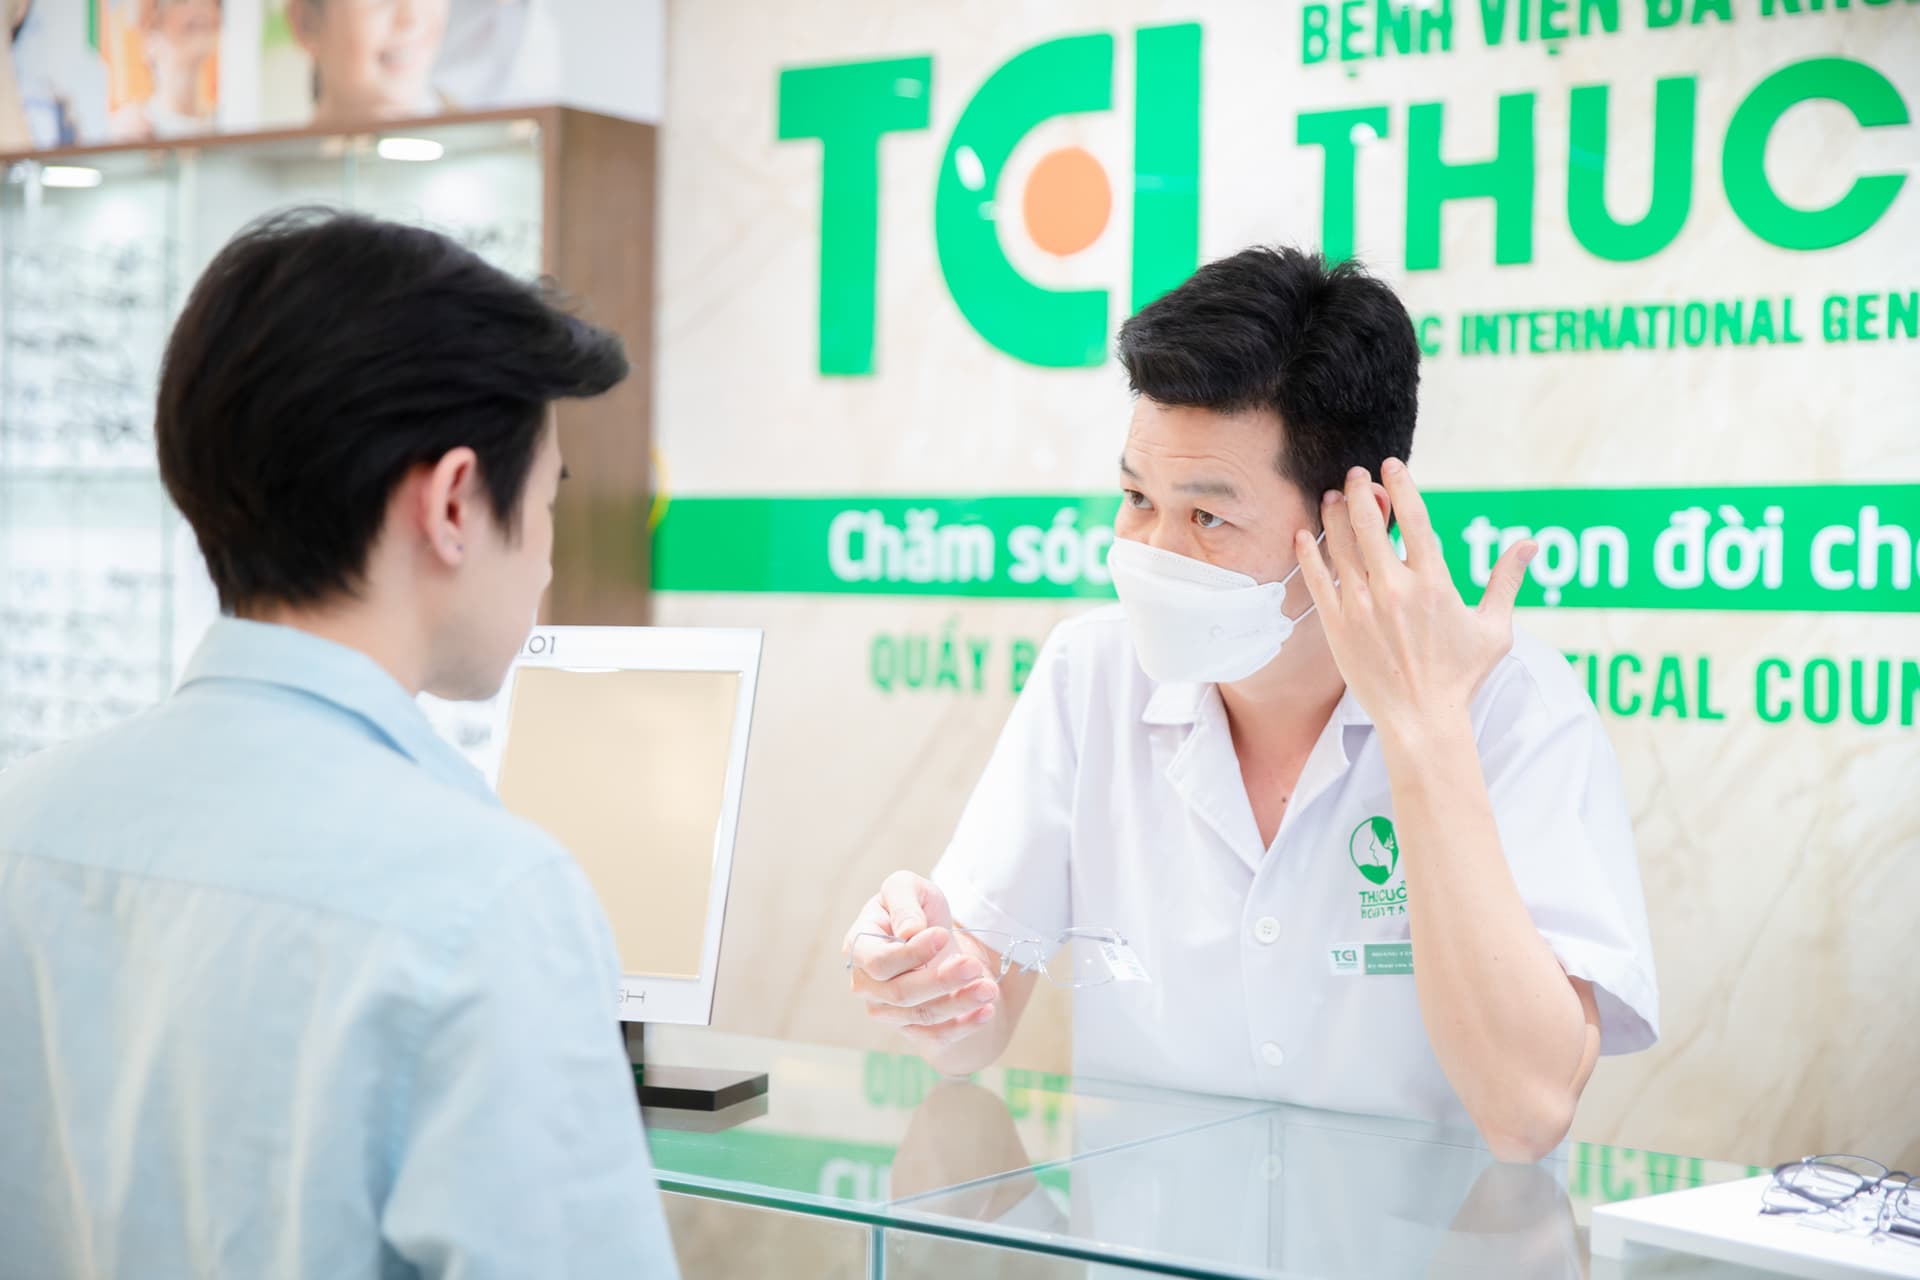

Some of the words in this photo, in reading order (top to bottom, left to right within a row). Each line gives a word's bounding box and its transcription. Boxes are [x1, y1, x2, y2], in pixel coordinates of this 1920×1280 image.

[777, 22, 1202, 376] TCI
[1461, 297, 1803, 356] INTERNATIONAL
[1822, 291, 1919, 343] GEN
[827, 507, 996, 584] Chăm
[1462, 516, 1630, 606] trọn
[1653, 504, 1785, 590] đời
[1810, 504, 1920, 590] ch
[1565, 654, 1726, 721] ICAL
